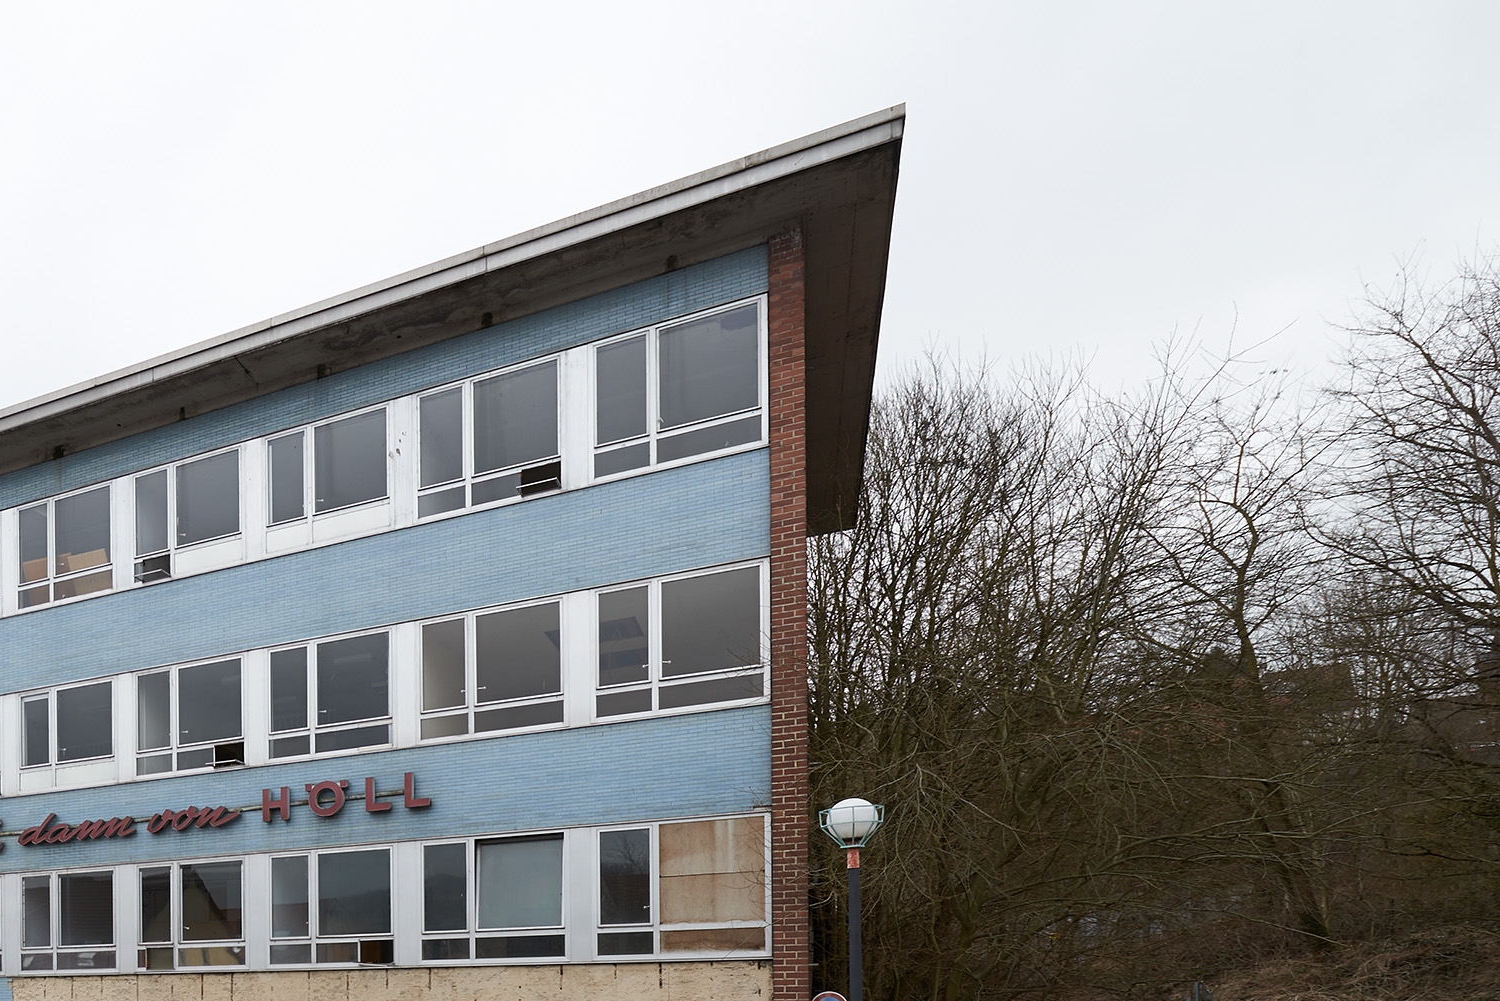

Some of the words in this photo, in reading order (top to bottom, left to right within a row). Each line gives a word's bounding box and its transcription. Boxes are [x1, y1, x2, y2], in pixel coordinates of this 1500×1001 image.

[18, 812, 138, 848] dann
[147, 805, 243, 835] von
[262, 772, 432, 823] HÖLL
